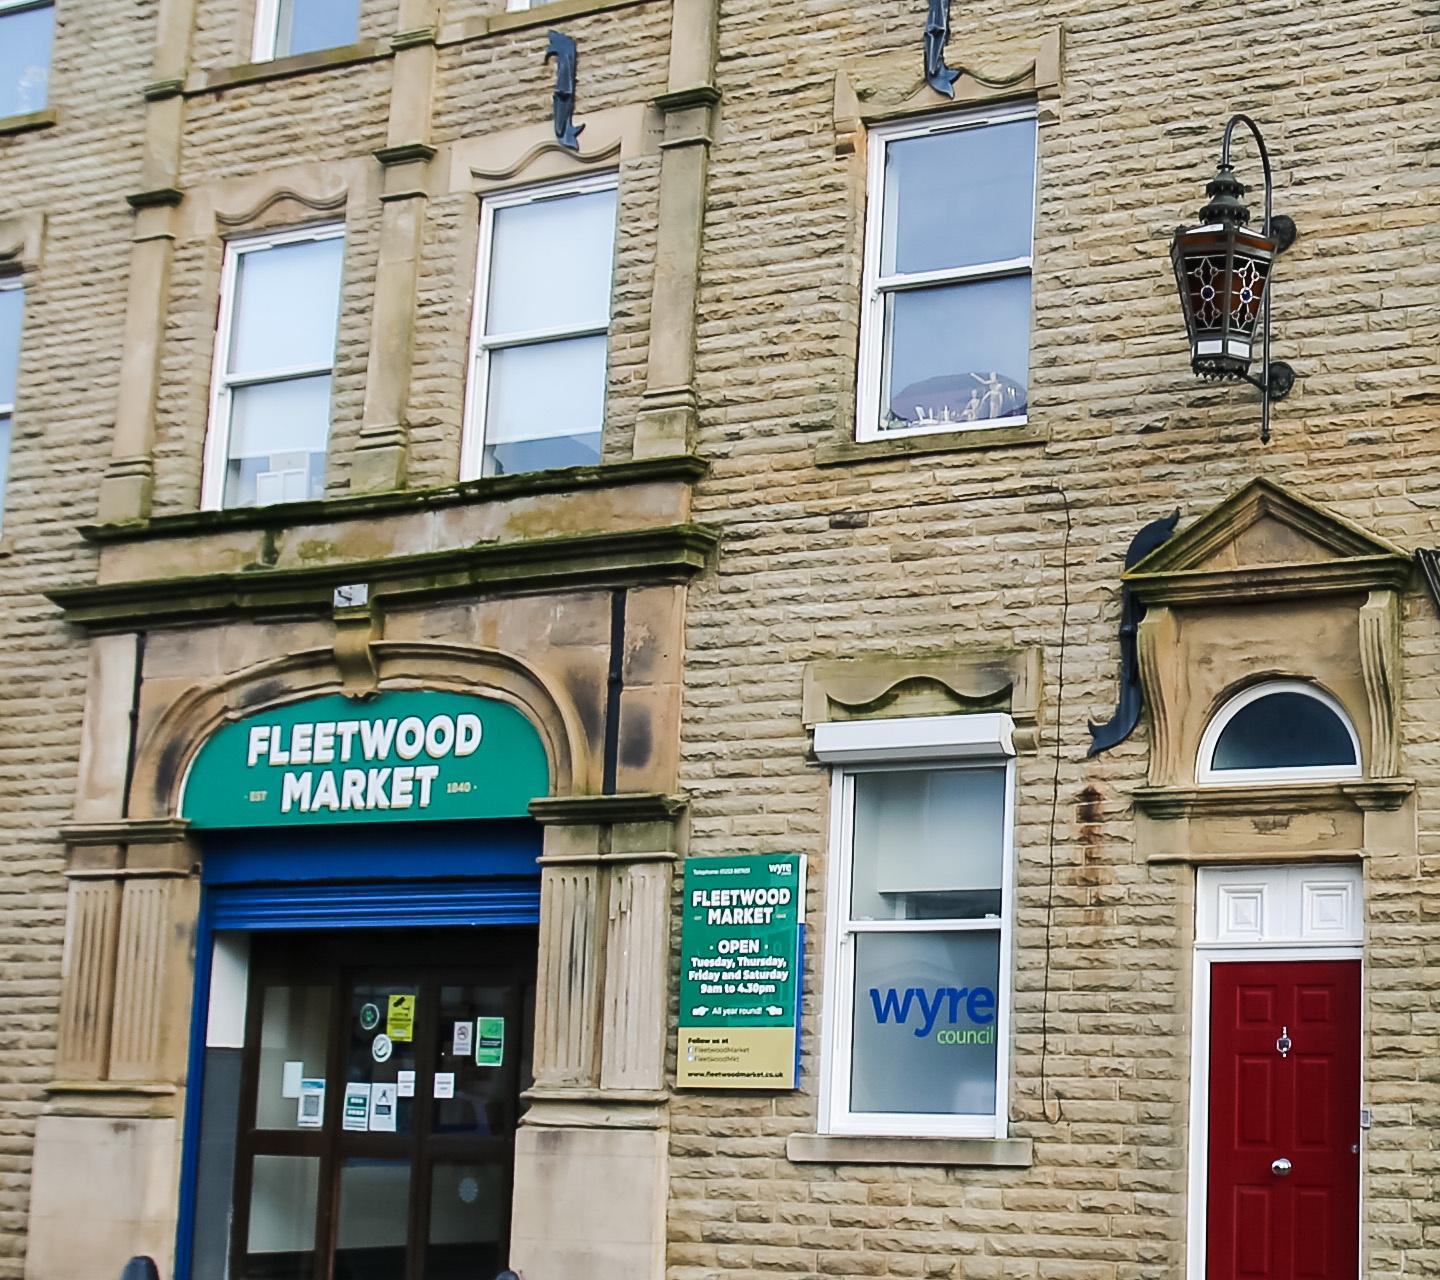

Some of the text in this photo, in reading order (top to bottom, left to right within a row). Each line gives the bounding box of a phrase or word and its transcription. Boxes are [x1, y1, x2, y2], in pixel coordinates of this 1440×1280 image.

[247, 713, 482, 766] FLEETWOOD
[281, 765, 439, 812] MARKET
[769, 864, 792, 875] wyre
[692, 888, 791, 907] FLEETWOOD
[708, 907, 773, 925] MARKET
[718, 939, 760, 954] OPEN
[691, 956, 787, 969] Tuesday, Thursday,
[688, 969, 789, 982] Friday and Saturday
[700, 983, 776, 995] 9am to 4.30pm
[712, 1007, 722, 1015] All
[723, 1008, 738, 1016] year
[869, 986, 995, 1037] wyre
[937, 1026, 994, 1044] council
